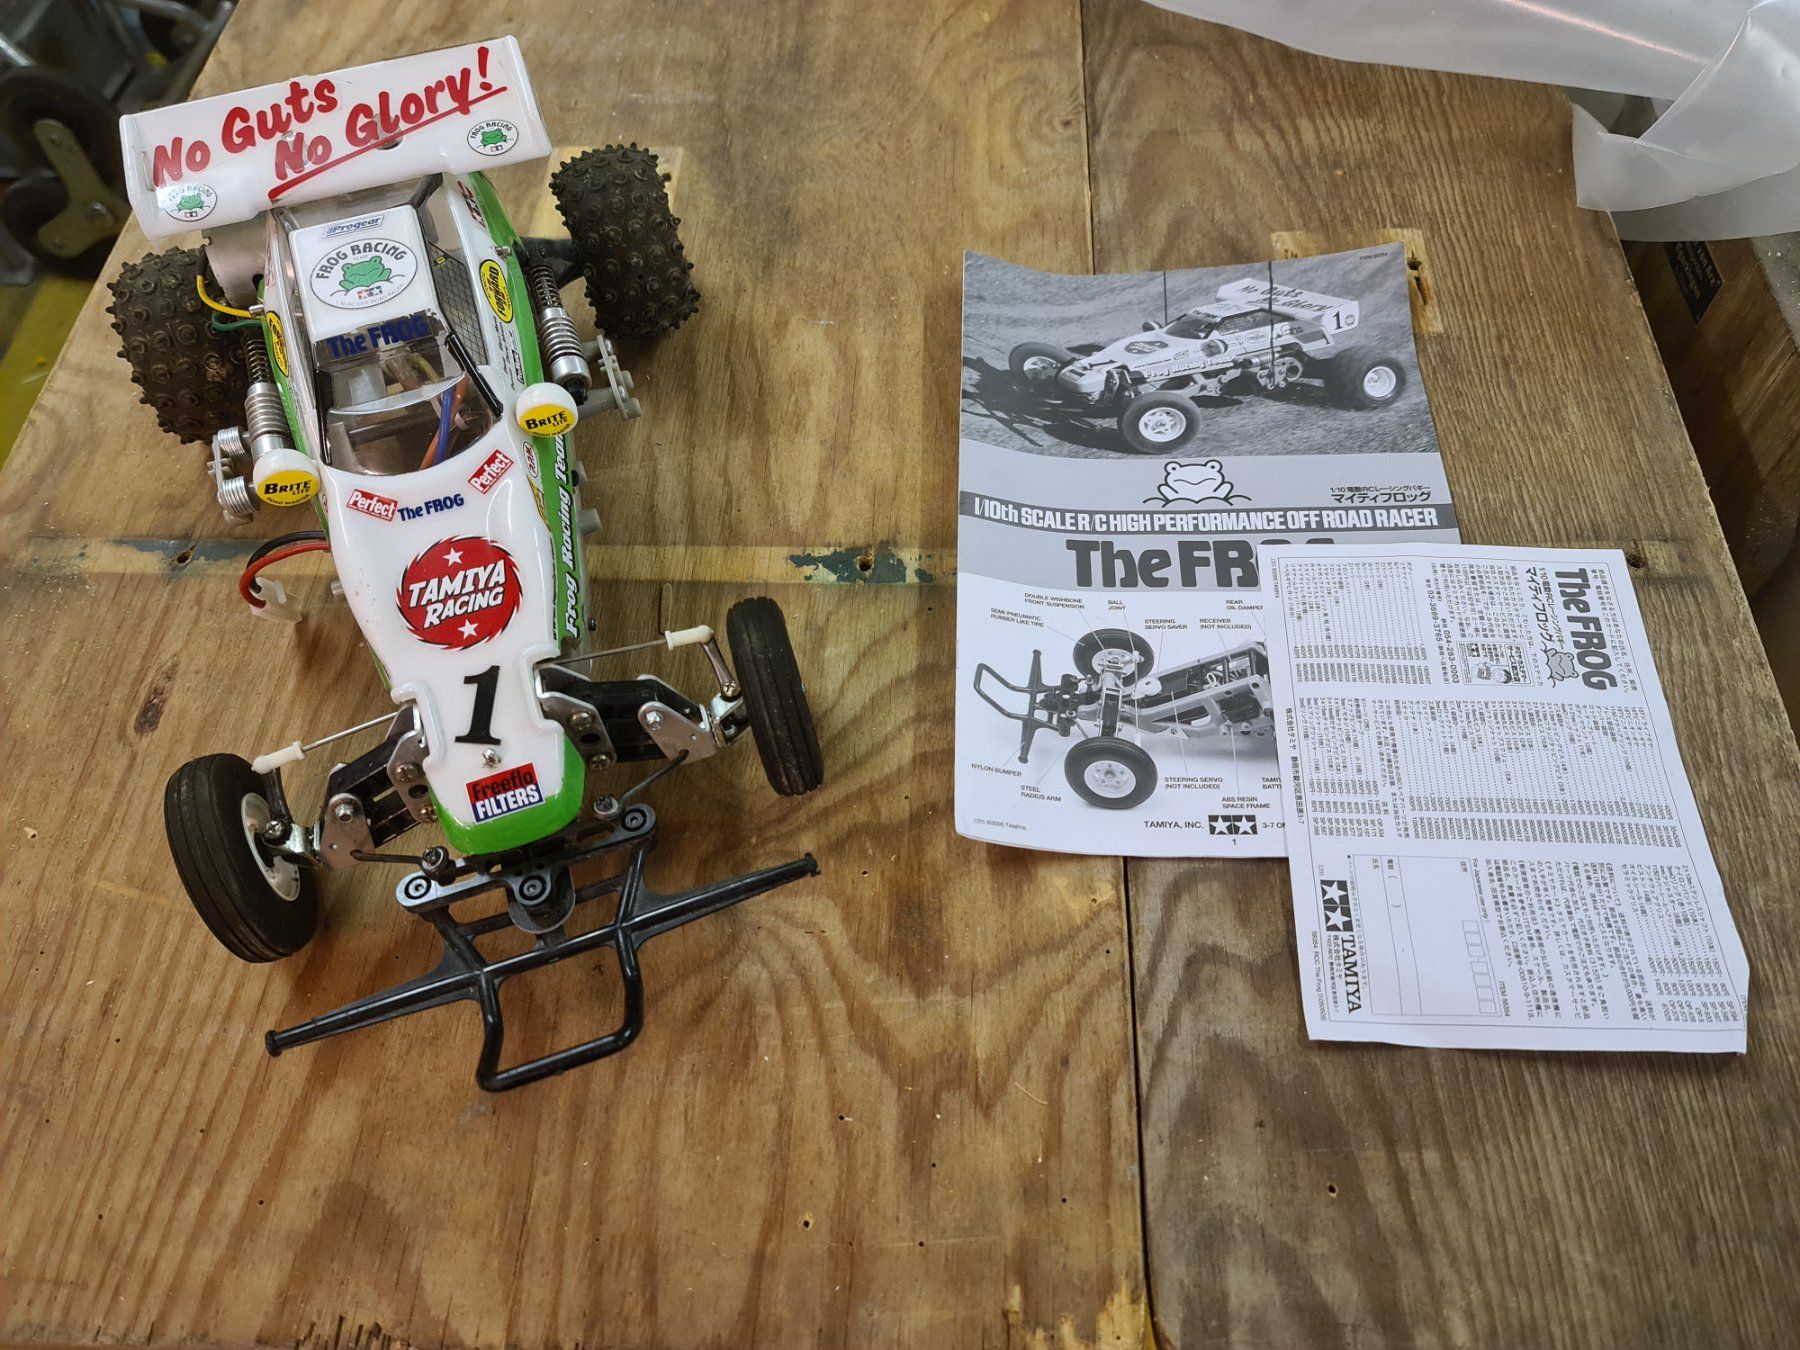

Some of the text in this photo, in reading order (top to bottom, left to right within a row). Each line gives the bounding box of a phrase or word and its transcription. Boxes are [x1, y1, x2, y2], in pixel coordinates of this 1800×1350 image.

[275, 46, 492, 180] No Glory!
[486, 121, 513, 133] RACING
[153, 79, 338, 187] No Guts
[316, 242, 407, 279] FROG RACING
[488, 266, 507, 318] FORWARD
[326, 318, 430, 358] The FROG
[1332, 310, 1344, 330] 1
[264, 480, 312, 495] BRITE
[471, 452, 510, 489] Perfect
[350, 491, 396, 517] Perfect
[398, 493, 464, 521] The FROG
[1331, 492, 1431, 504] マイティフロッグ
[557, 485, 575, 572] Racing
[1020, 507, 1076, 531] SCALE
[1077, 513, 1107, 531] R/C
[1109, 514, 1151, 532] HIGH
[1152, 510, 1286, 532] PERFORMANCE
[1286, 510, 1320, 530] OFF
[1320, 509, 1371, 529] ROAD
[1373, 508, 1439, 528] RACER
[1066, 538, 1335, 588] The FR
[408, 559, 506, 608] TAMIYA
[423, 586, 504, 629] RACING
[565, 573, 579, 639] Frog
[1024, 598, 1085, 610] FRONT SUSPENSION
[1525, 566, 1555, 644] マイティフロッグ
[1555, 568, 1618, 690] The FROG
[1443, 630, 1459, 684] 054-283-0003
[454, 665, 502, 746] 1
[472, 769, 536, 801] Freeflo
[971, 763, 1022, 777] NYLON BUMPER
[475, 784, 540, 820] FILTERS
[1021, 785, 1041, 793] STEEL
[1021, 791, 1045, 800] RADIUS
[1143, 821, 1204, 830] TAMIYA, INC.
[1341, 935, 1362, 1014] TAMIYA
